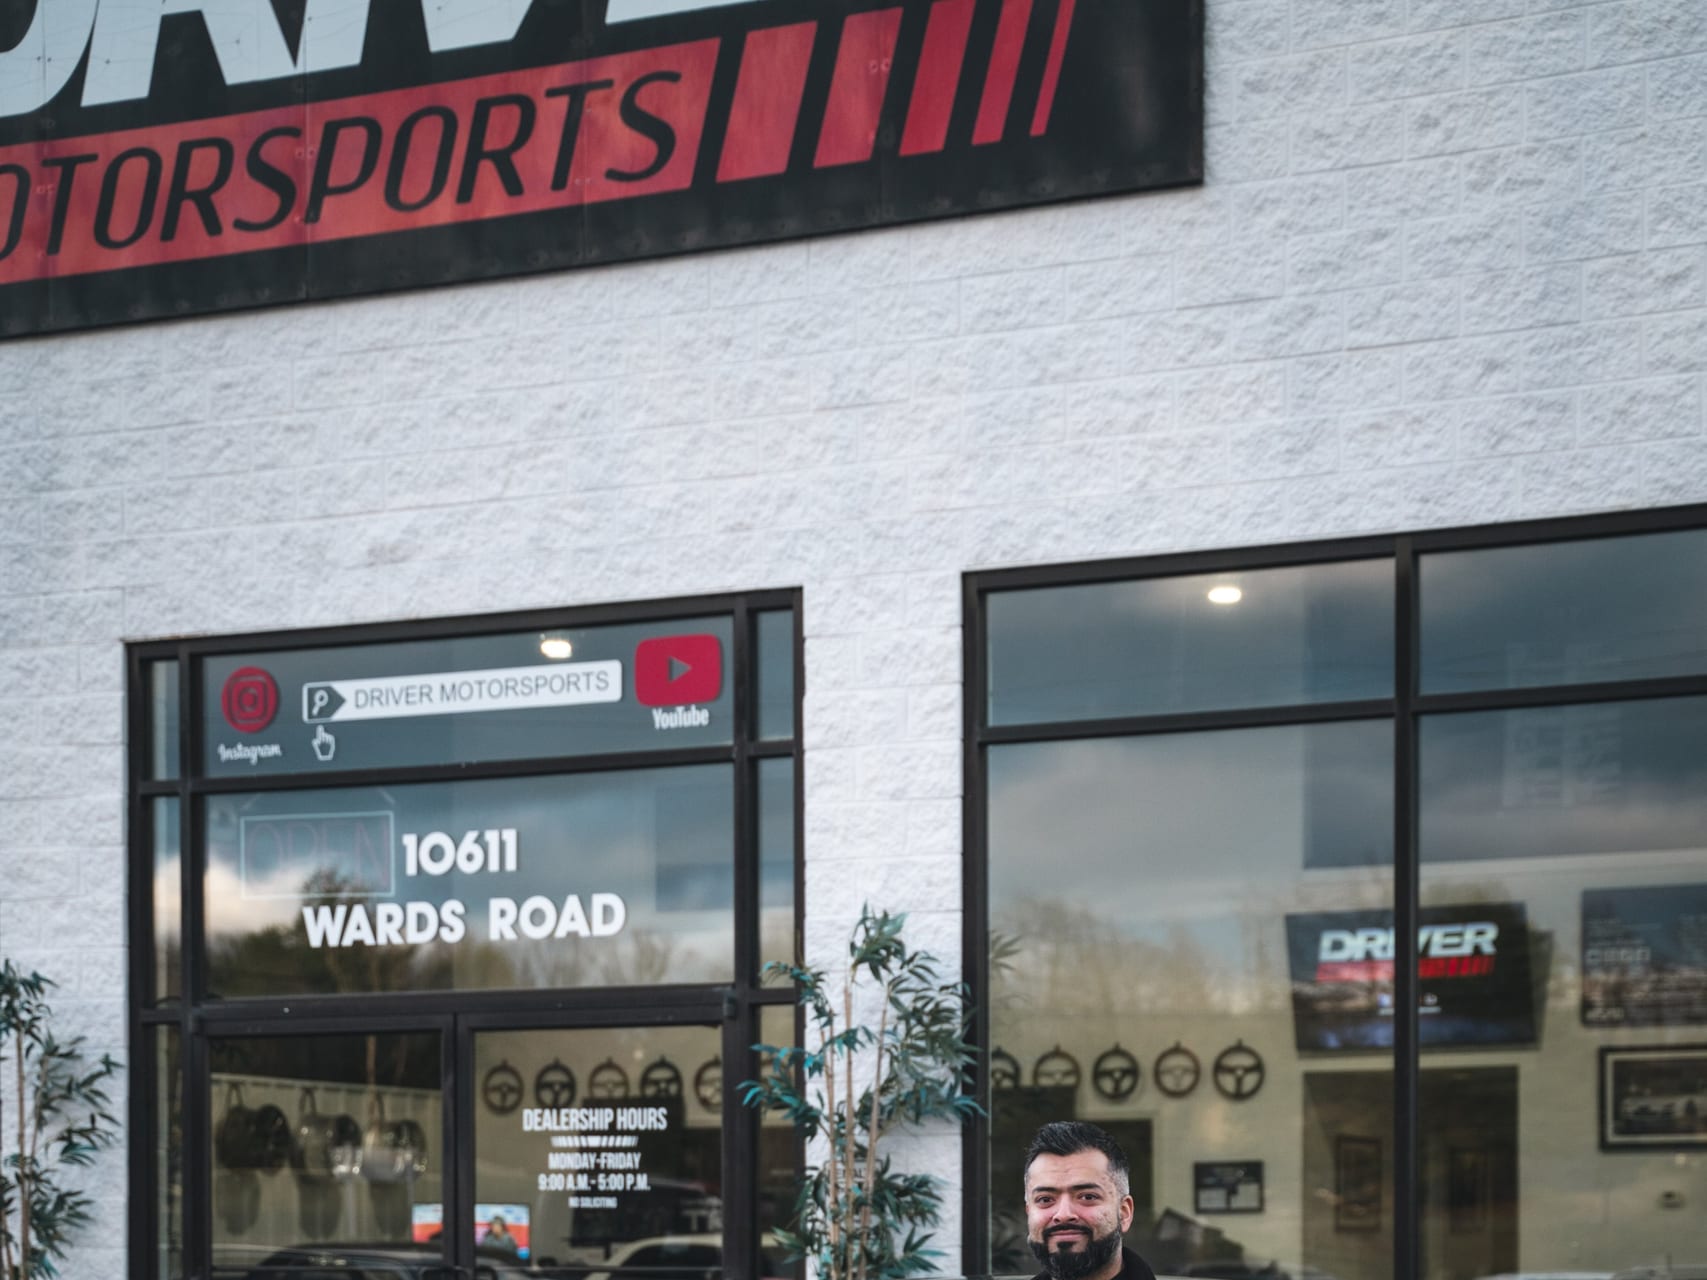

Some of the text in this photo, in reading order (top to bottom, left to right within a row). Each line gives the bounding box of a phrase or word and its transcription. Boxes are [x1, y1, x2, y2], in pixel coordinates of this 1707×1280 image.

[354, 670, 610, 710] DRIVER MOTORSPORTS
[652, 705, 710, 730] YouTube
[217, 742, 283, 766] Instagram
[402, 827, 518, 877] 10611
[302, 892, 627, 948] WARDS ROAD
[1318, 921, 1499, 963] DRER
[522, 1106, 669, 1132] DEALERSHIP HOURS
[538, 1173, 565, 1191] 9:00
[598, 1173, 624, 1191] 5:00
[626, 1173, 651, 1191] P.M.
